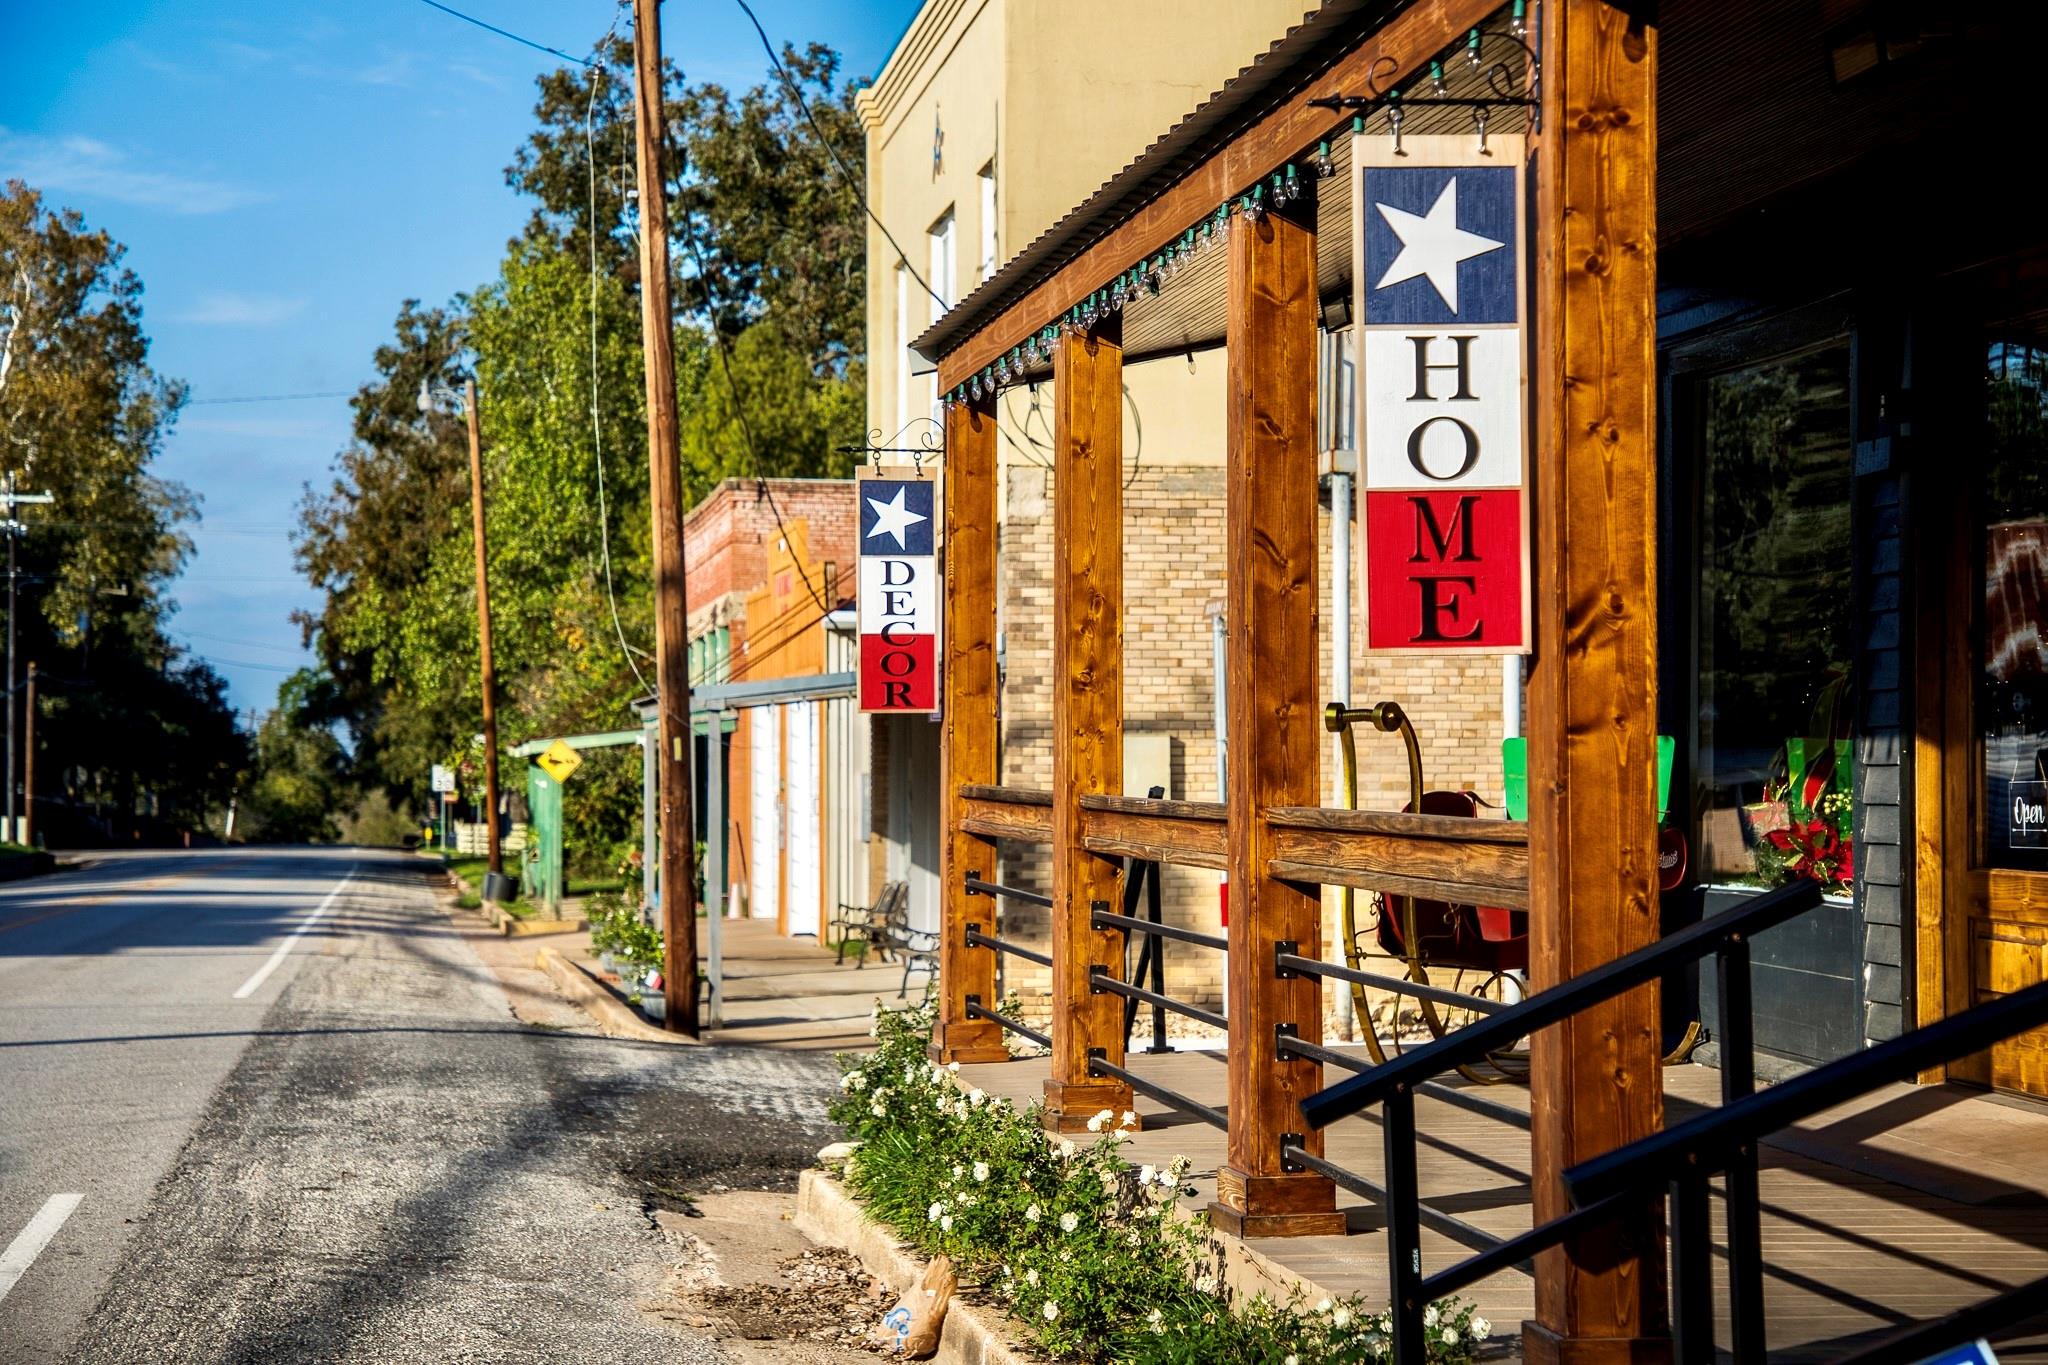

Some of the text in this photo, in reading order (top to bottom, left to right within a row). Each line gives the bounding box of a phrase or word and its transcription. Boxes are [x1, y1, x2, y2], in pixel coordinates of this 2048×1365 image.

[1405, 335, 1484, 644] HOME
[880, 560, 917, 708] DECOR
[2014, 796, 2046, 837] Open
